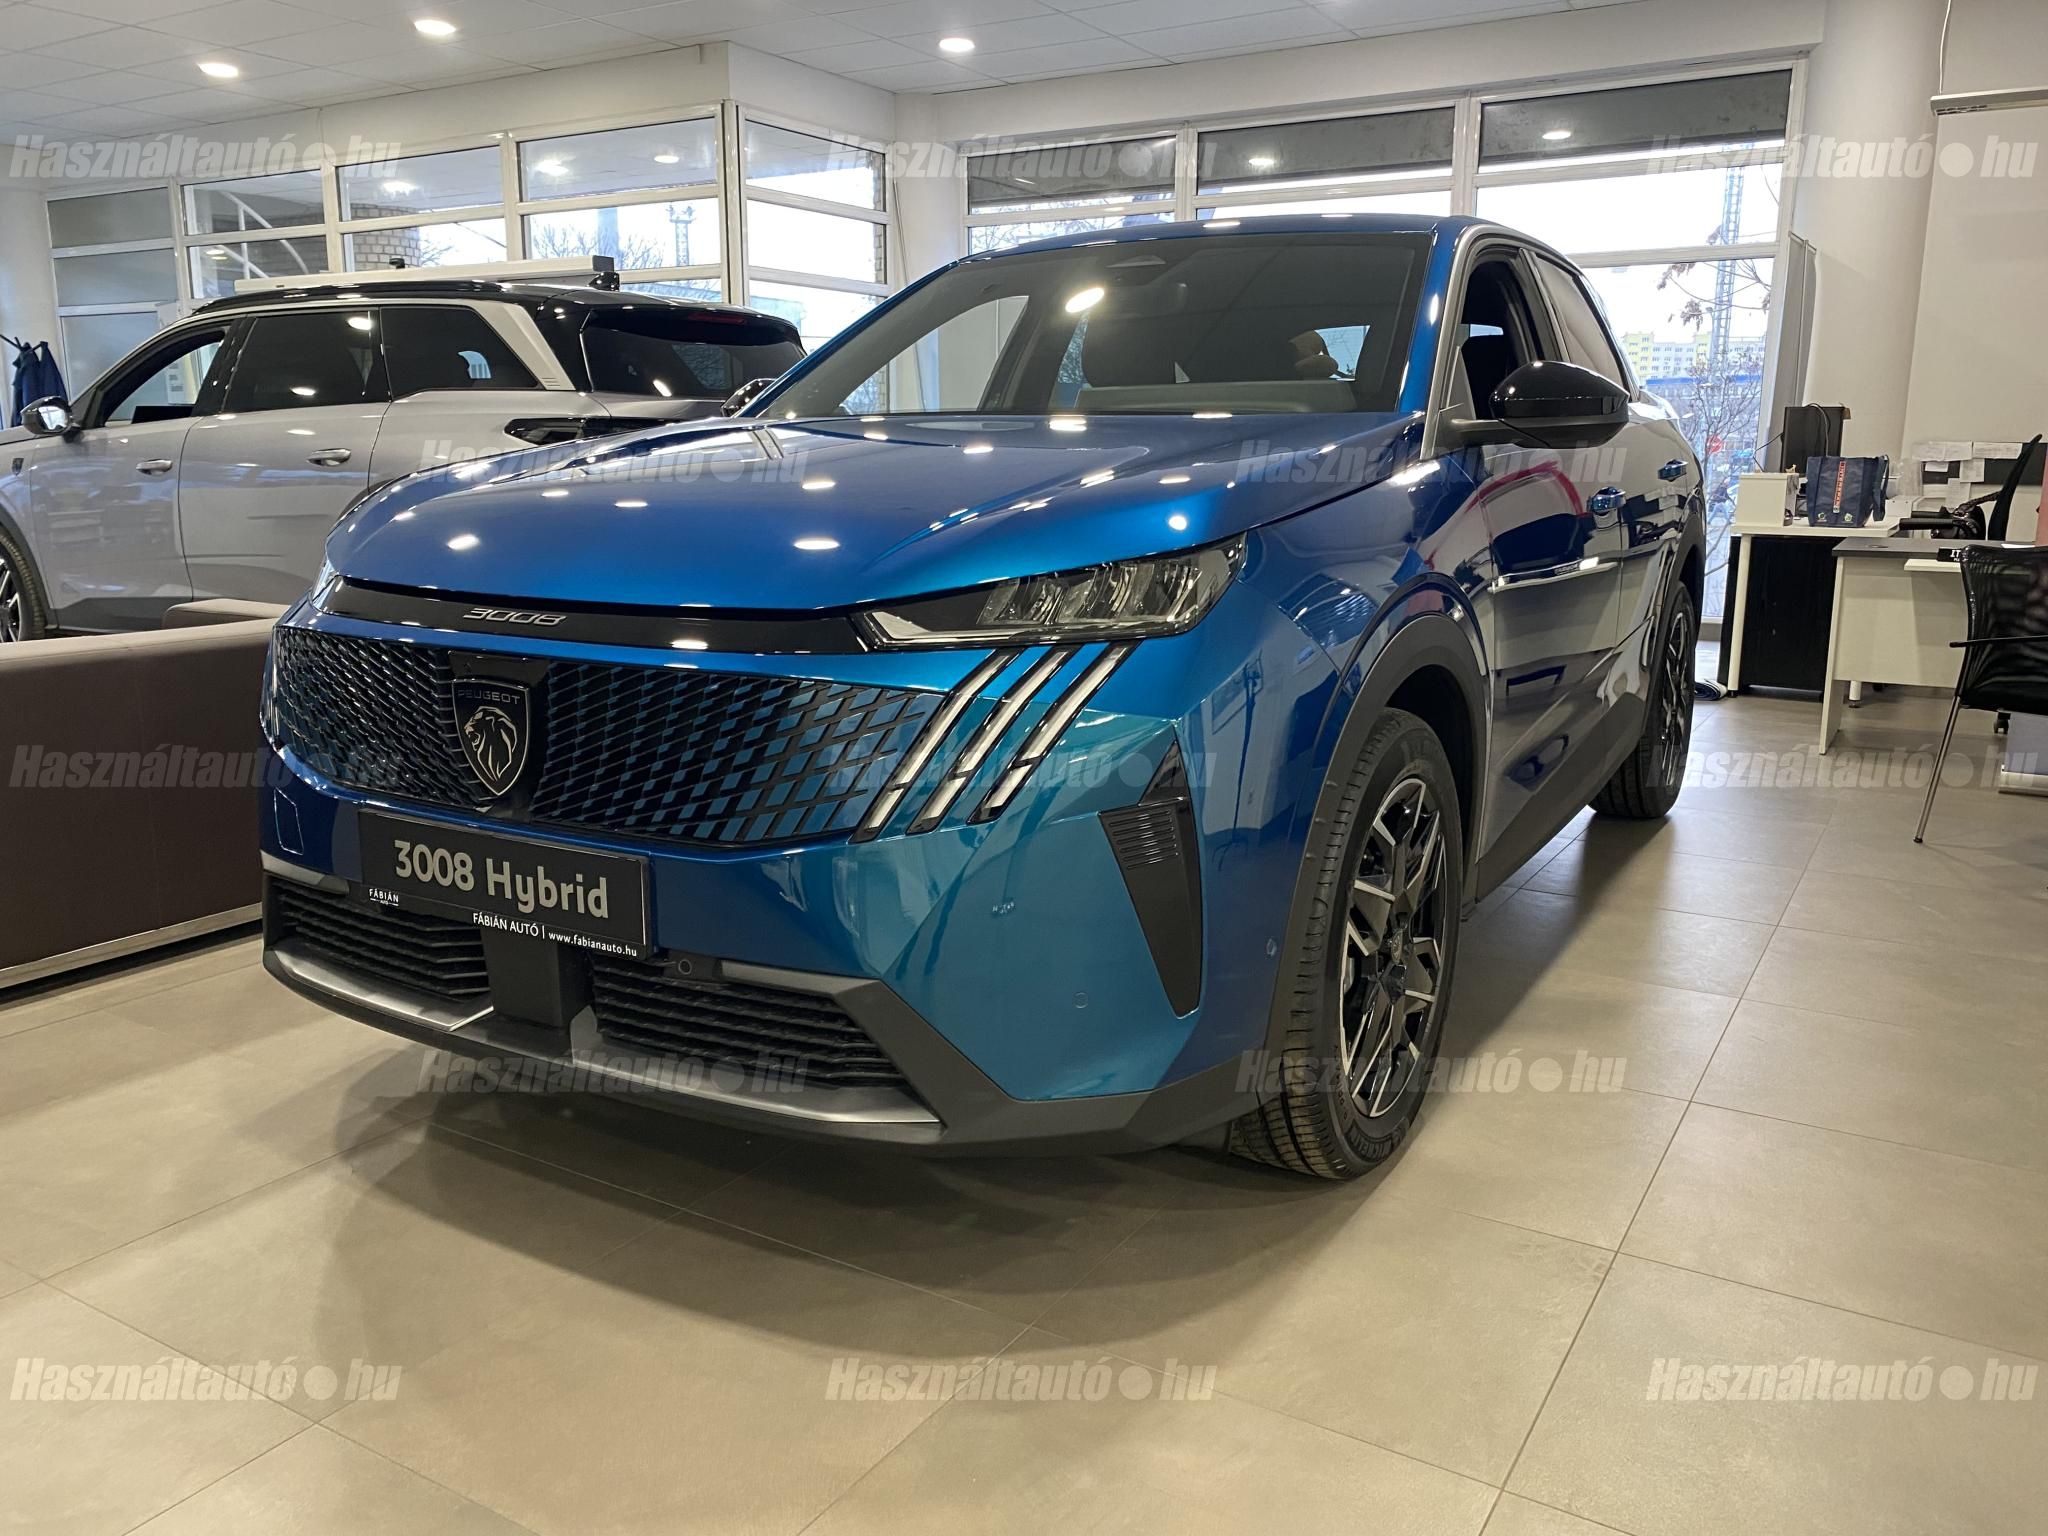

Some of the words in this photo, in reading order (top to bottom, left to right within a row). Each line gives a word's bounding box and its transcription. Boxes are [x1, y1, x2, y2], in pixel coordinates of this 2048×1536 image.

[463, 607, 567, 626] 3008
[457, 689, 520, 704] PEUGEOT
[394, 839, 475, 892] 3008
[485, 857, 609, 919] Hybrid
[472, 912, 508, 931] FÁBIÁN
[509, 922, 539, 937] AUTÓ
[548, 931, 637, 957] www.fabianauto.hu
